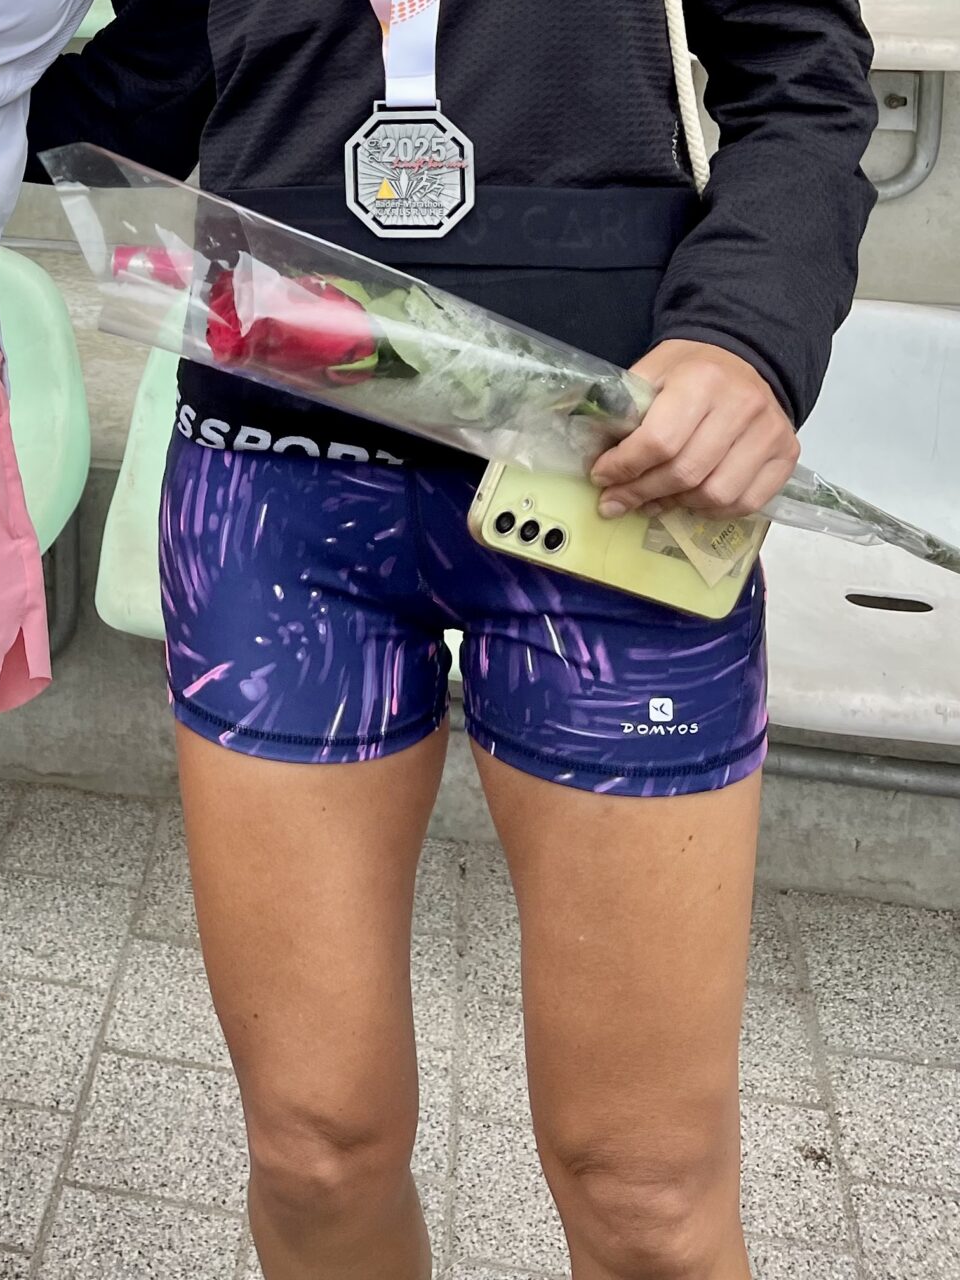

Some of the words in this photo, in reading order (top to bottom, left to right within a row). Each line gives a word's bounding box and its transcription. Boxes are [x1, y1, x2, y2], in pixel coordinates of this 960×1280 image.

[382, 136, 447, 163] 2025
[375, 200, 444, 209] Baden-Marathon
[375, 208, 444, 217] KARLSRUHE
[711, 522, 736, 551] EURO
[620, 722, 699, 736] DOMYOS
